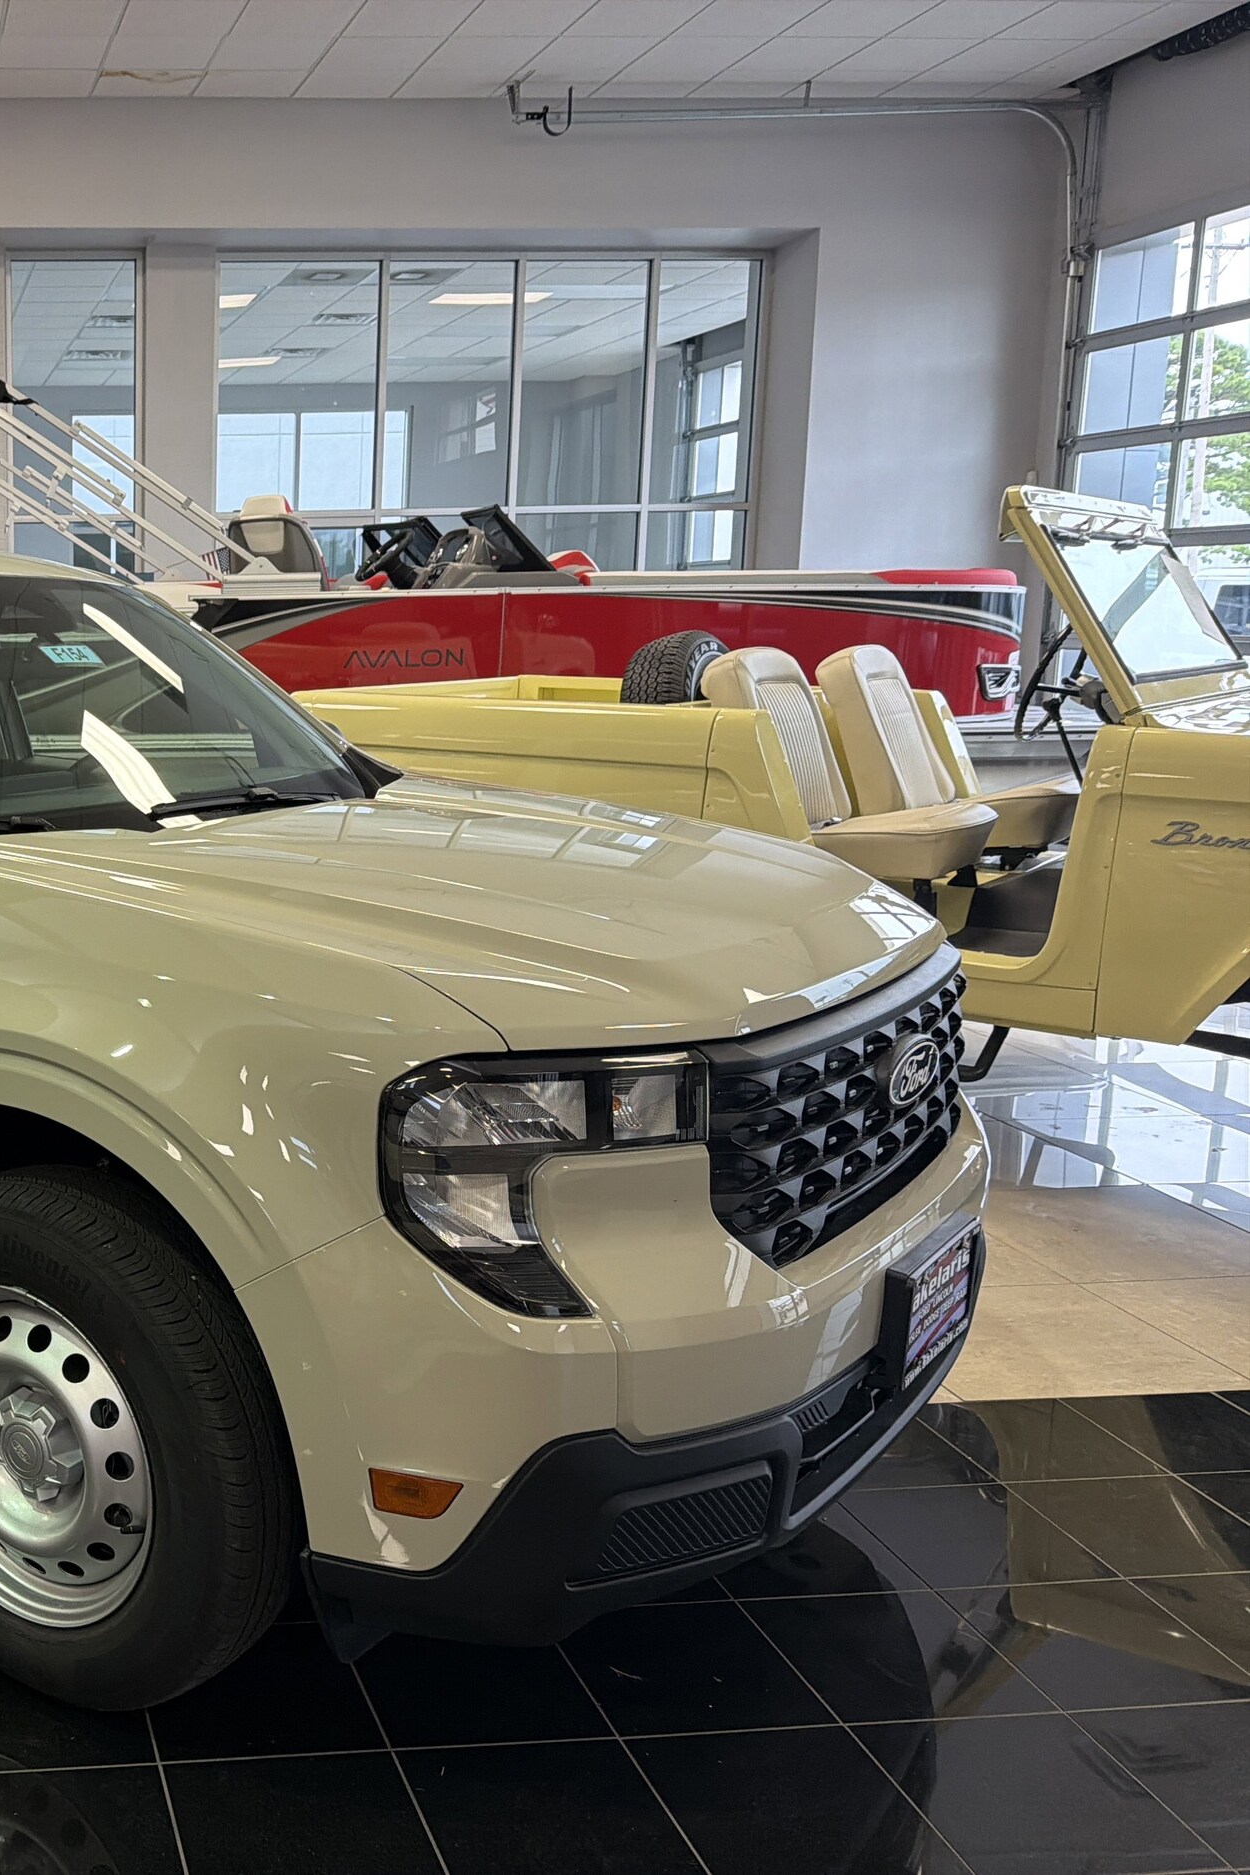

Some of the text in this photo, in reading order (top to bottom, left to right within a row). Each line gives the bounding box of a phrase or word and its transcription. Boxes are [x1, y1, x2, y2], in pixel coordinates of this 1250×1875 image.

[50, 646, 90, 662] F154
[343, 648, 464, 669] AVALON
[900, 1046, 934, 1098] Ford
